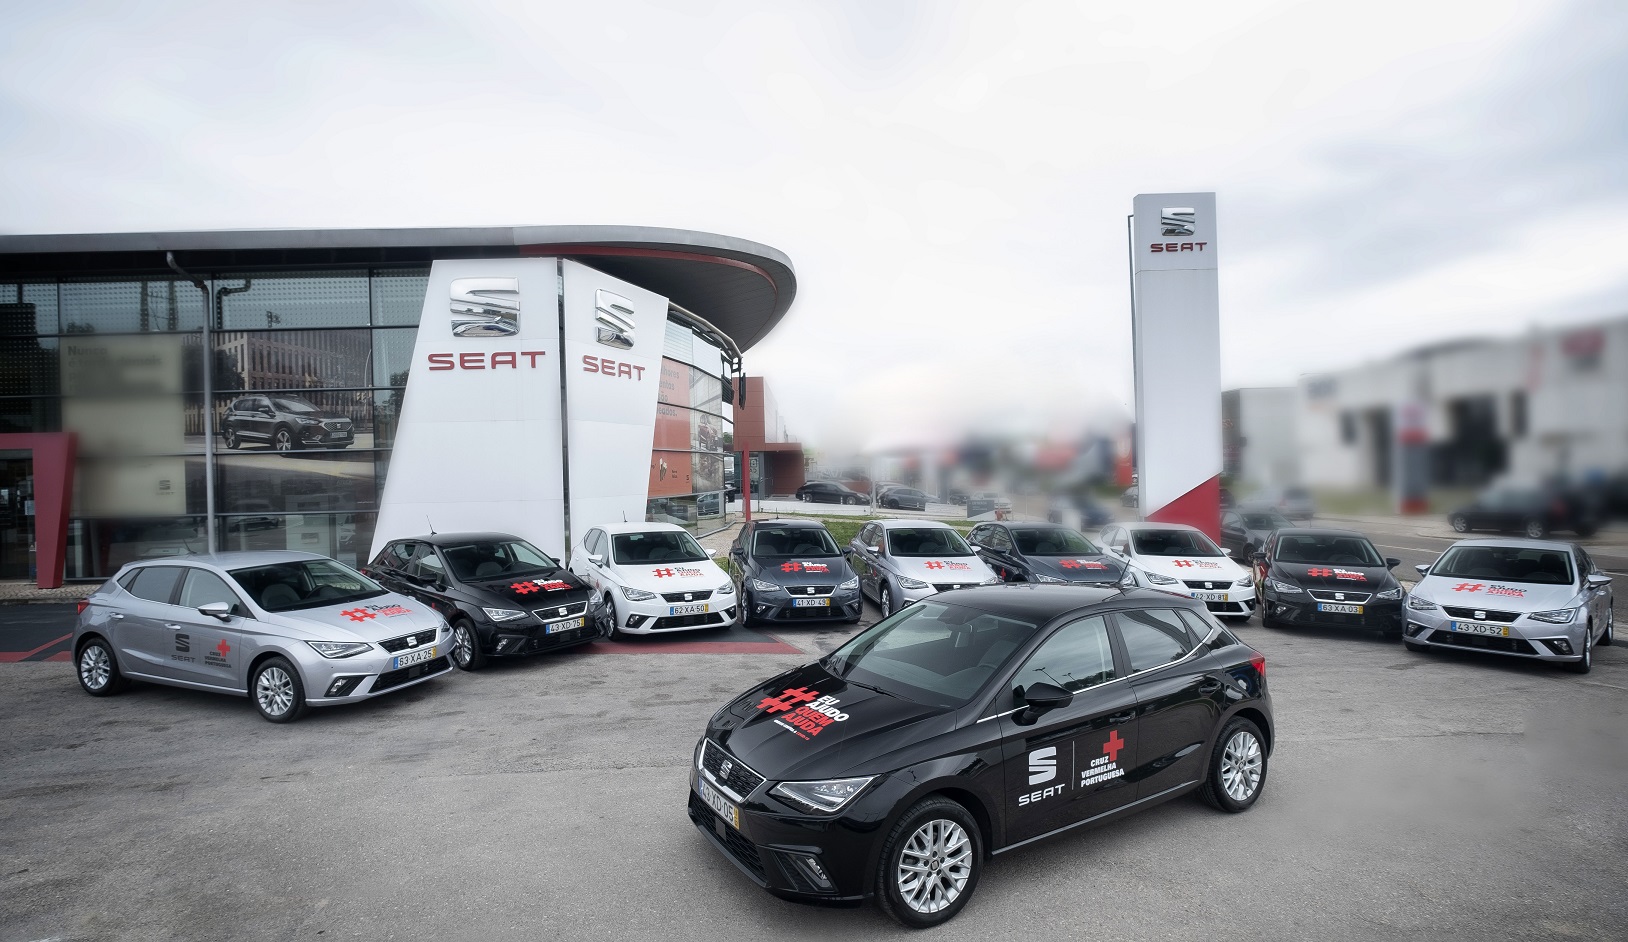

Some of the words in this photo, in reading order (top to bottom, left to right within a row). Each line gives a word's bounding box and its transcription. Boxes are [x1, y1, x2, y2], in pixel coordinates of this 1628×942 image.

[1150, 242, 1208, 253] SEAT
[427, 350, 546, 371] SEAT
[582, 354, 646, 381] SEAT
[171, 654, 196, 663] SEAT
[817, 695, 840, 705] EU
[795, 706, 835, 727] QUEM
[805, 701, 849, 722] AJUDO
[781, 712, 823, 736] AJUDA
[1081, 762, 1117, 779] VERMELHA
[1090, 756, 1109, 767] CRUZ
[1081, 768, 1125, 788] PORTUGUESA
[1018, 783, 1065, 807] SEAT
